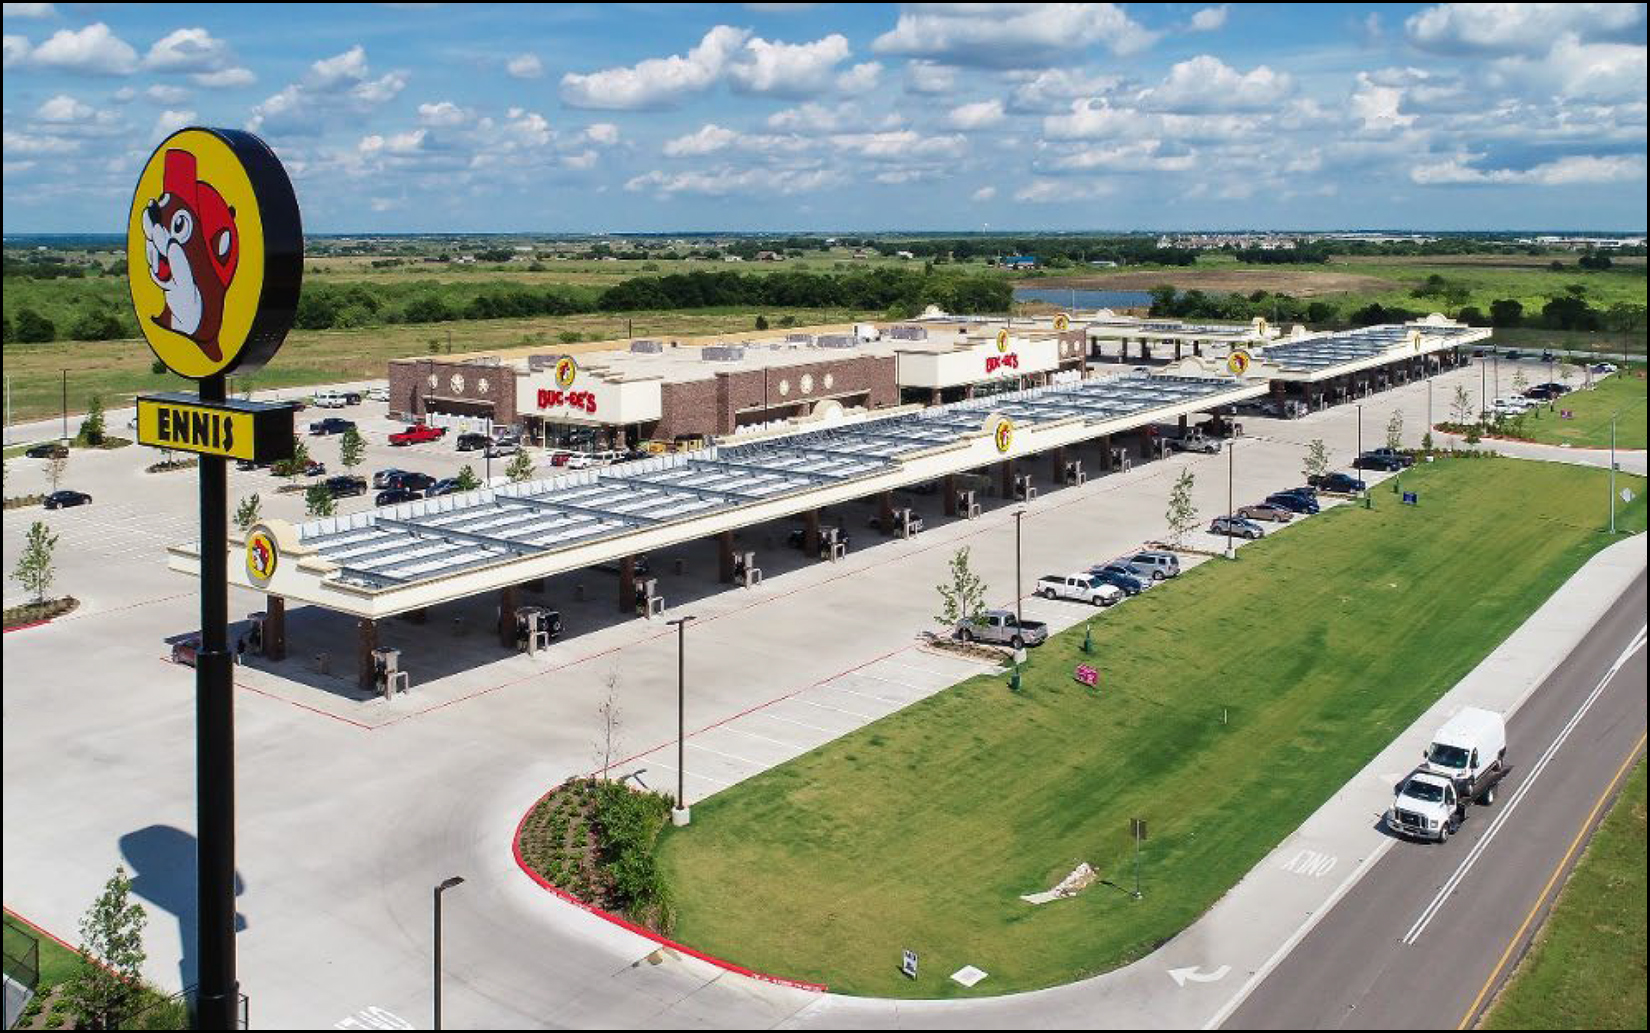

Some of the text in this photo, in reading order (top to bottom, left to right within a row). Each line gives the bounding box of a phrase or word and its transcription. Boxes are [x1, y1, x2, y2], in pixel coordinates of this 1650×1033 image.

[538, 389, 597, 413] BUC-EE'S
[158, 408, 233, 452] ENNIS
[1280, 850, 1338, 877] ONLY
